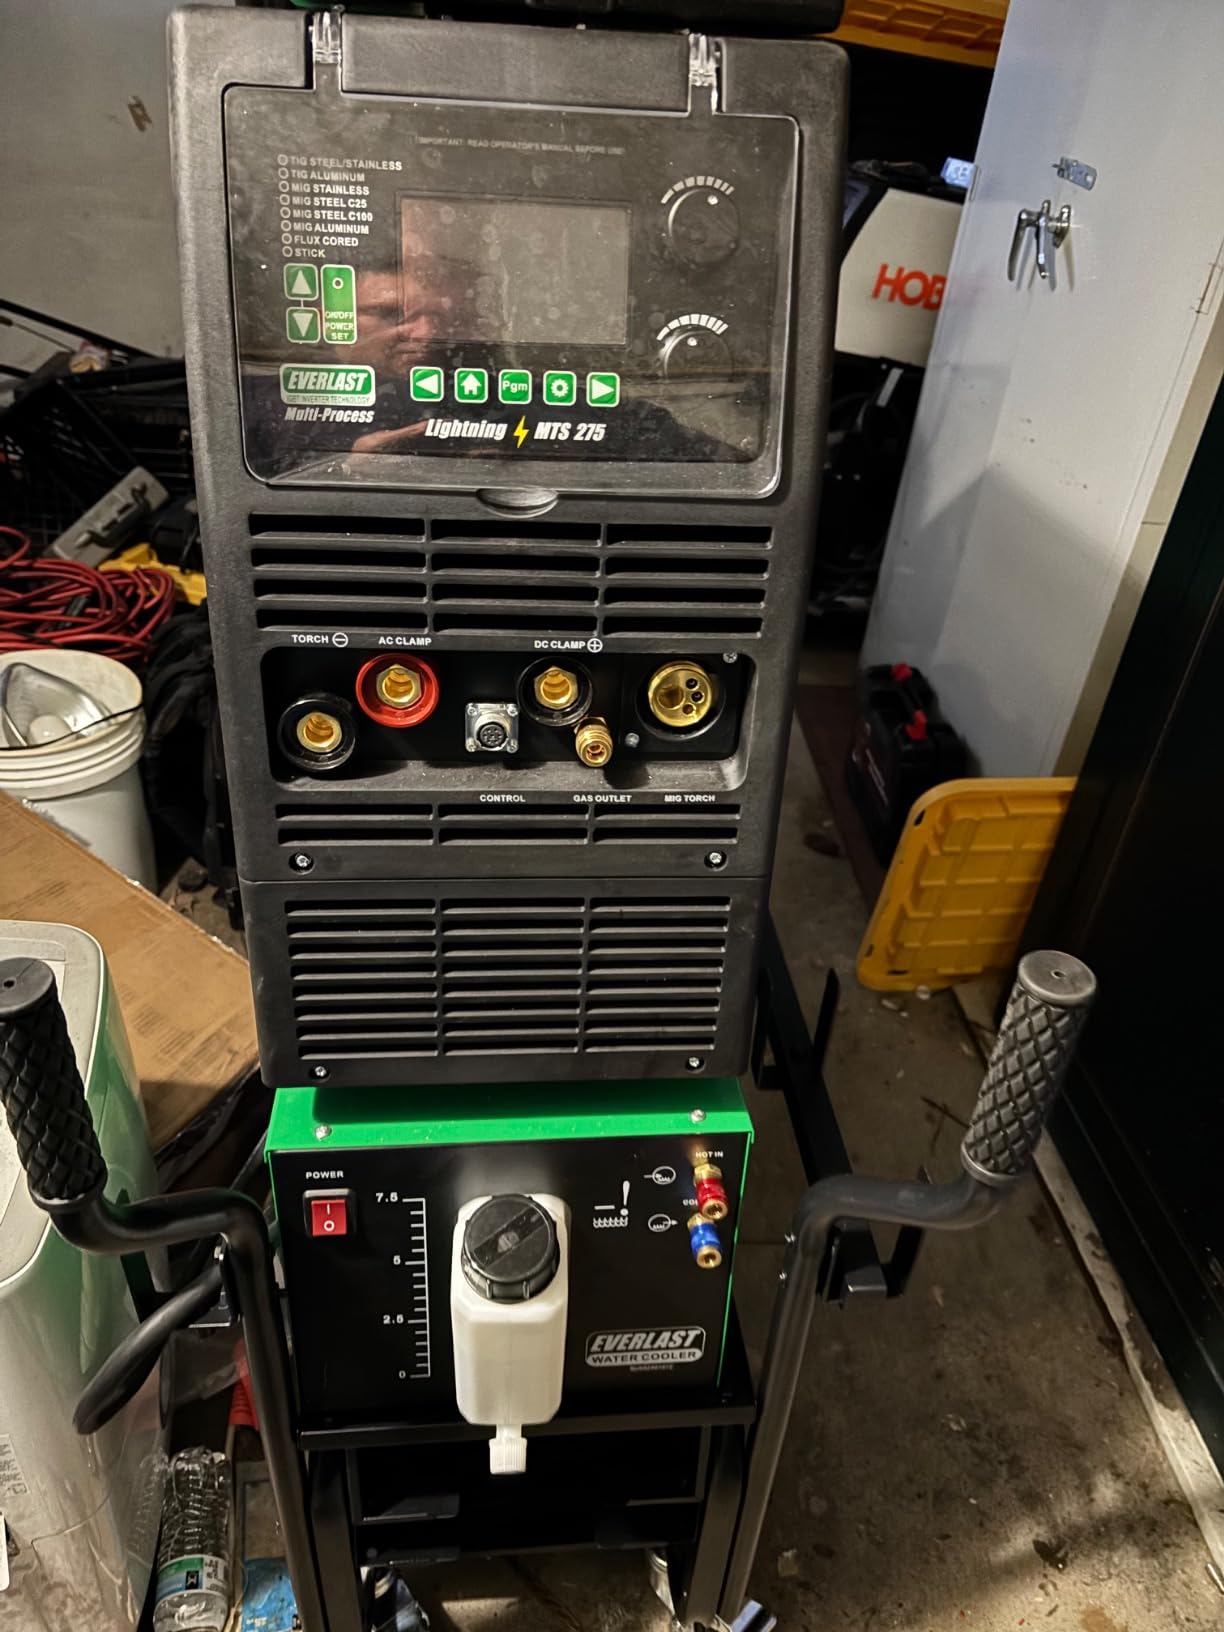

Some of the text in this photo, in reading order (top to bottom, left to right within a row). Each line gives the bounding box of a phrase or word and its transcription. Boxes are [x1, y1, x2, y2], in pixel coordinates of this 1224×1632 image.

[290, 155, 403, 171] TIG STEEL/STAINLESS
[291, 170, 366, 182] TIG ALUMINUM
[291, 184, 370, 196] MIG STAINLESS
[292, 197, 368, 209] MIG STEEL C25
[292, 210, 374, 222] MIG STEEL C100
[293, 223, 370, 235] MIG ALUMINUM
[294, 235, 359, 247] FLUX CORED
[294, 248, 326, 259] STICK
[325, 322, 354, 331] POWER
[331, 332, 350, 341] SET
[287, 370, 368, 392] EVERLAST
[502, 380, 528, 393] Pgm
[284, 406, 375, 424] Multi-Process
[424, 418, 607, 441] Lightning MTS 275
[291, 634, 329, 644] TORCH
[378, 636, 432, 647] AC CLAMP
[533, 640, 586, 650] DC CLAMP
[479, 794, 526, 804] CONTROL
[573, 794, 632, 803] GAS OUTLET
[664, 794, 716, 803] MIG TORCH
[305, 1170, 344, 1180] POWER
[375, 1192, 398, 1203] 7.5
[383, 1314, 404, 1325] 2.5
[590, 1329, 701, 1353] EVERLAST
[591, 1351, 697, 1364] WATER COOLER
